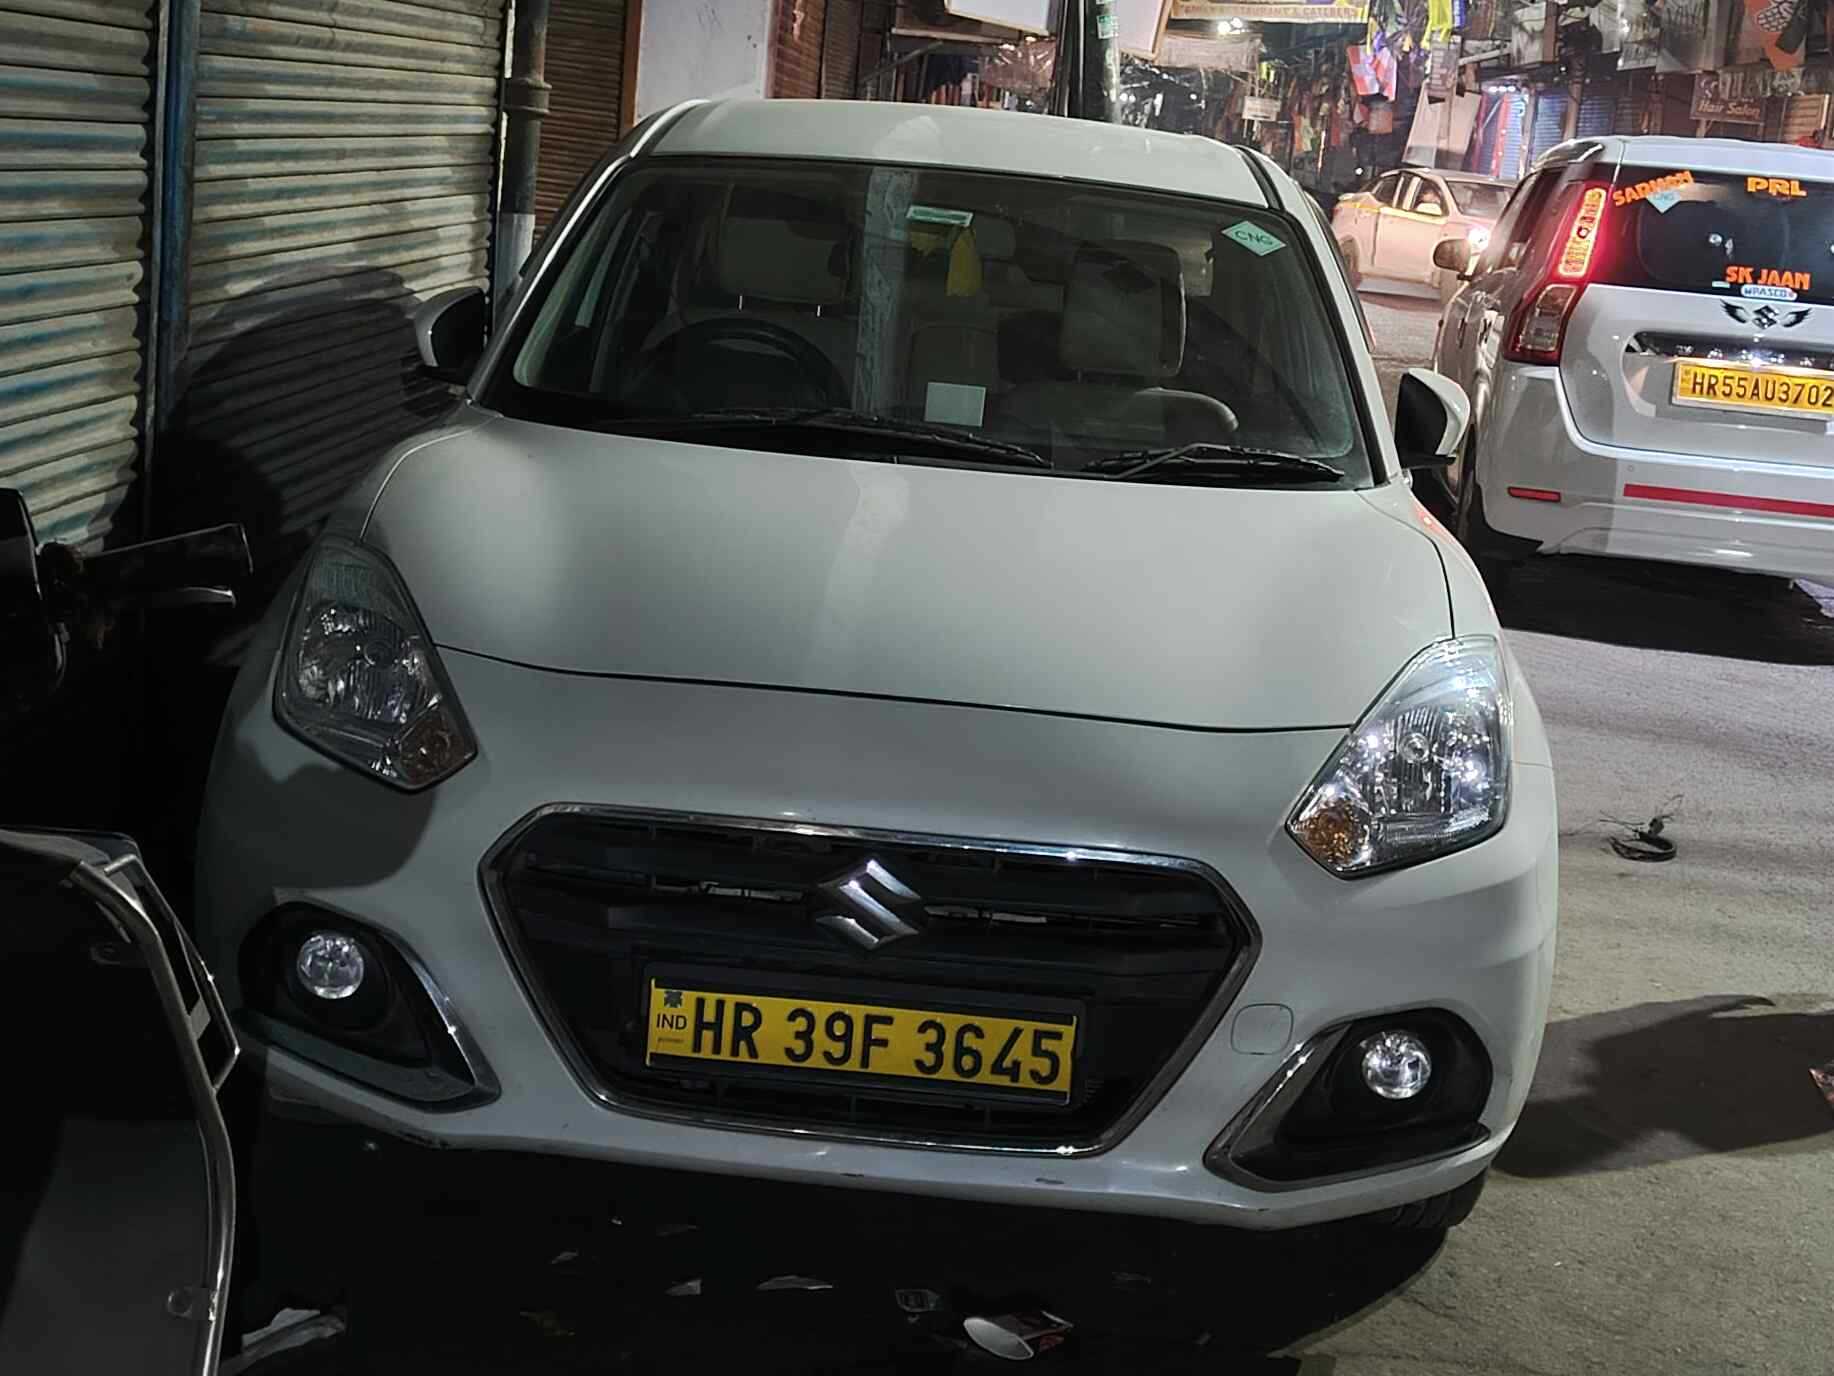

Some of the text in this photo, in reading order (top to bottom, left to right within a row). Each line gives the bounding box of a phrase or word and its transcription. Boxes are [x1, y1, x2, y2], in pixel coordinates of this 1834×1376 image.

[1727, 102, 1760, 119] Salon
[1747, 176, 1807, 197] PRL
[1234, 230, 1273, 246] CNG
[1726, 266, 1811, 290] SK JAAN
[1692, 371, 1834, 407] HR55AU3702
[656, 1013, 687, 1030] IND
[692, 997, 1064, 1085] HR 39F 3645
